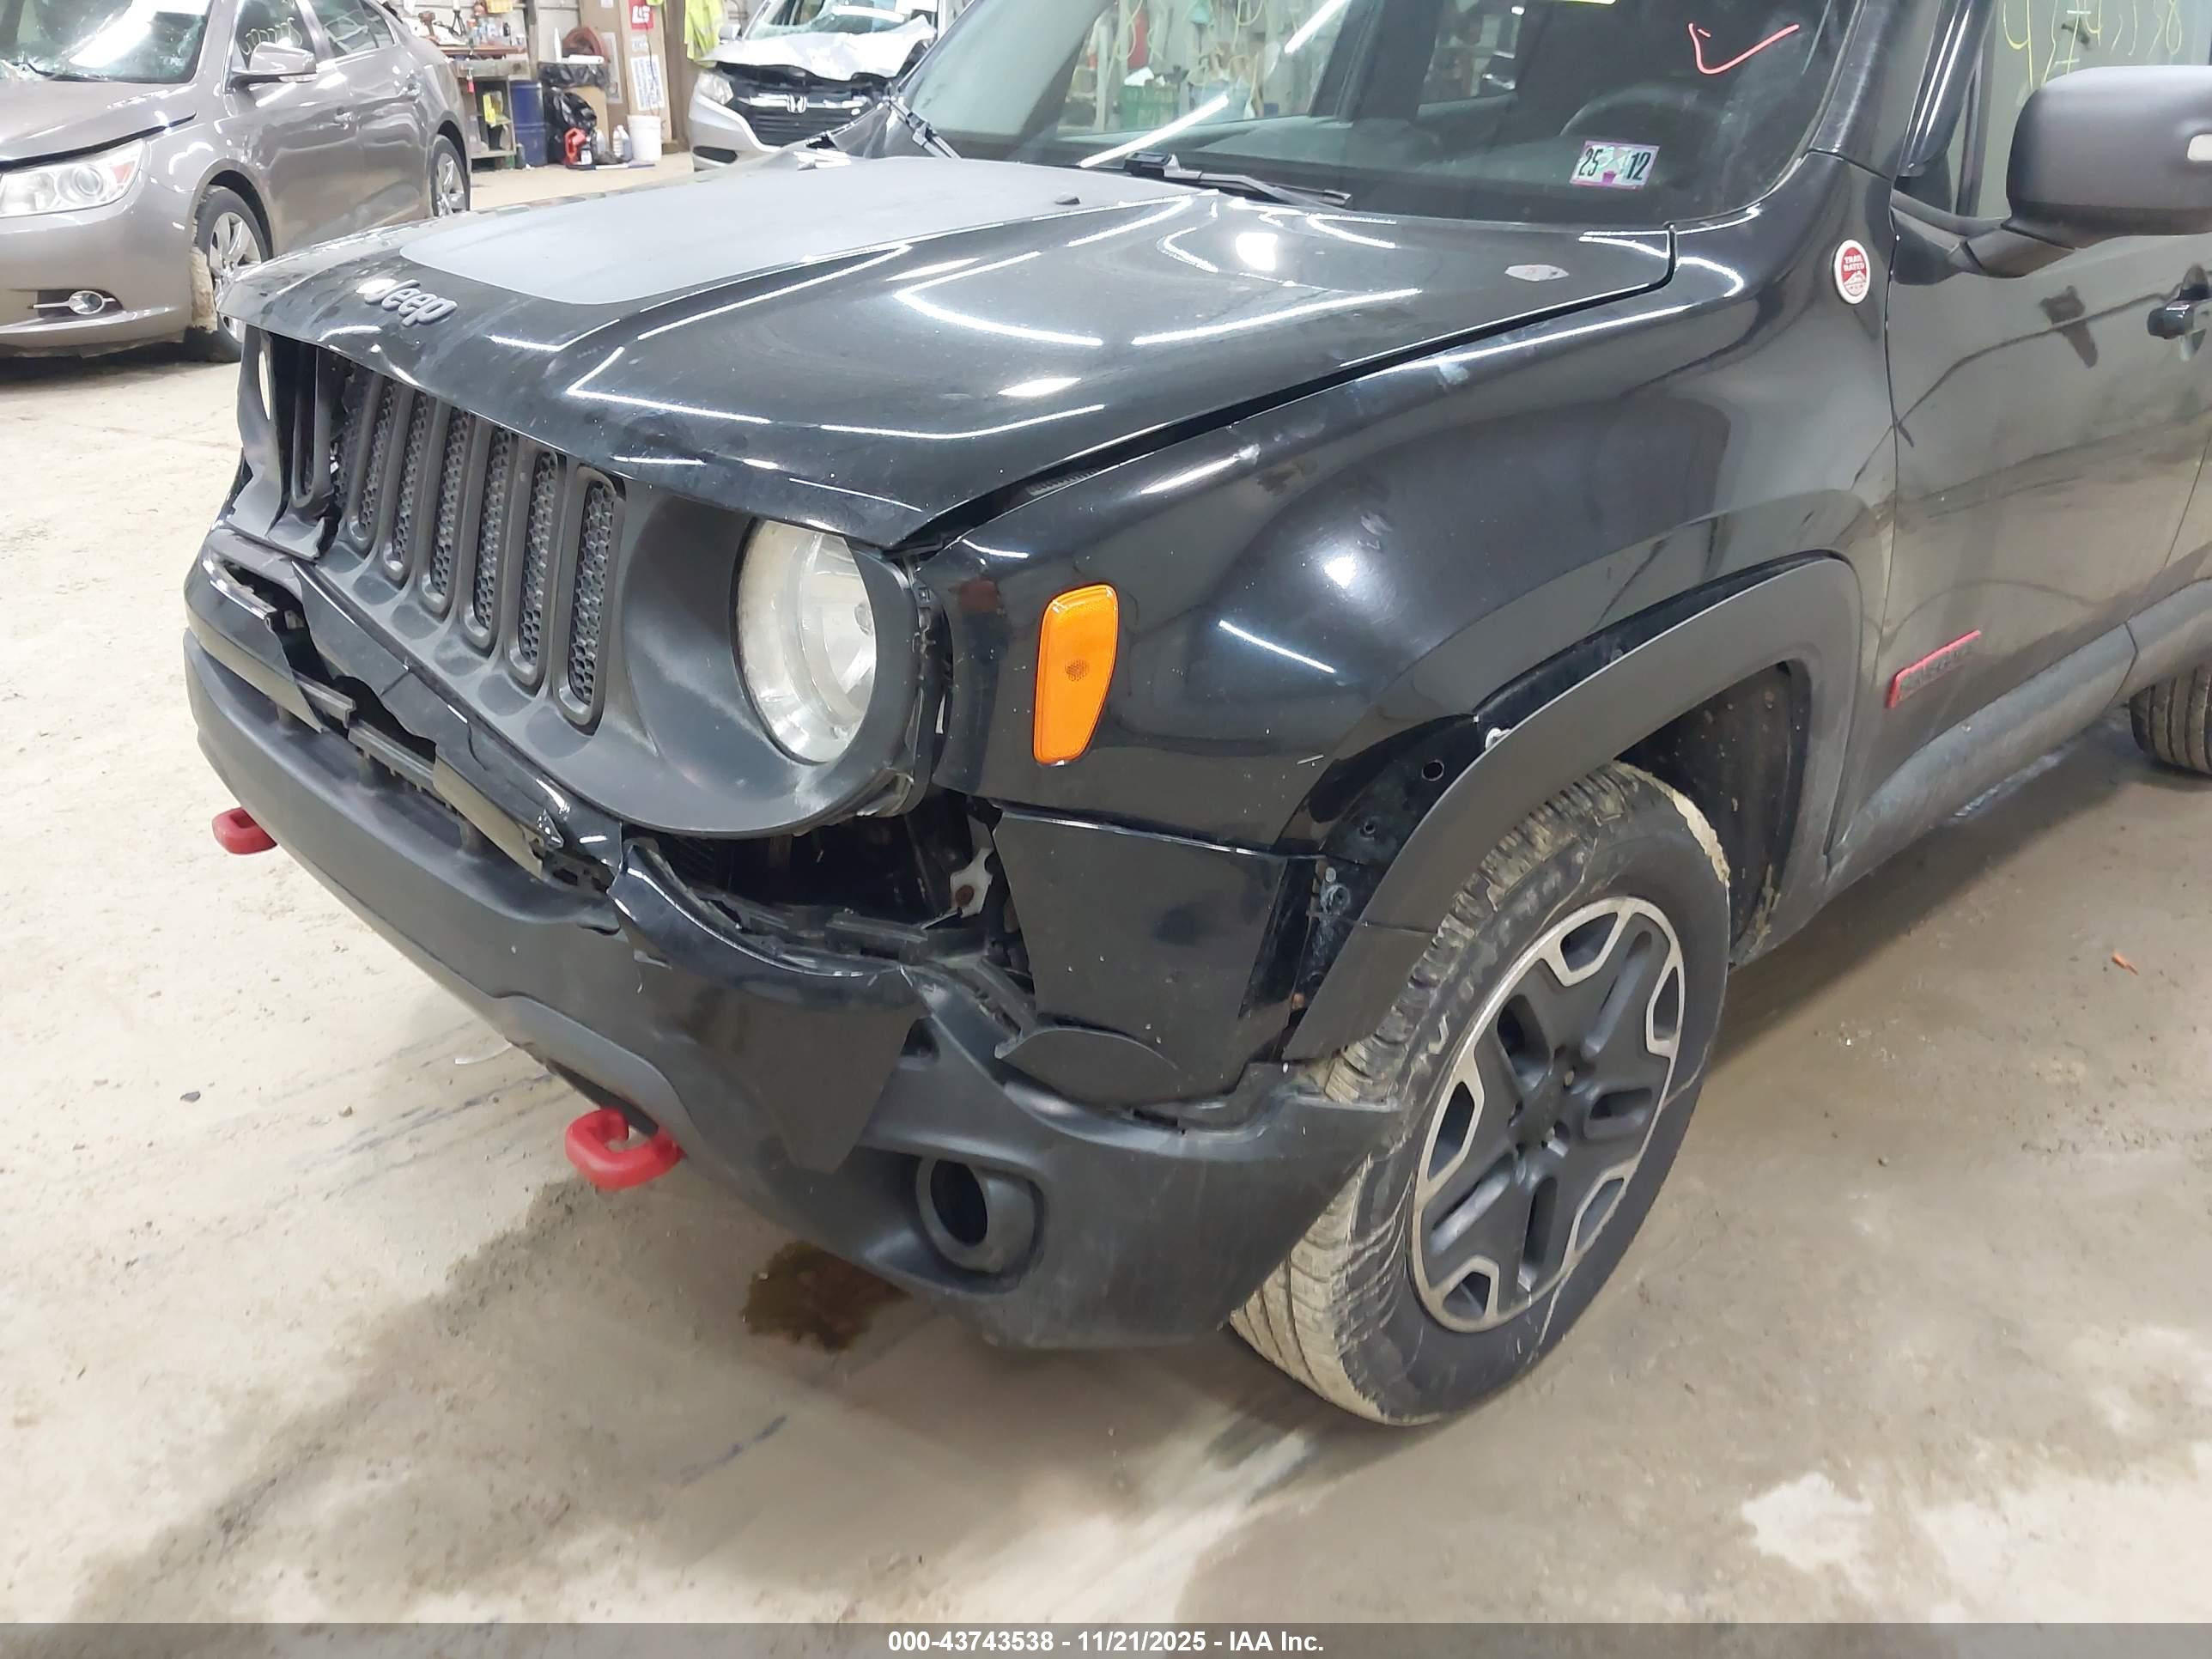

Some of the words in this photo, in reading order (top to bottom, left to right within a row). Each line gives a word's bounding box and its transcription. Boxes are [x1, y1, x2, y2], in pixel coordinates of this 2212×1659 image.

[1577, 148, 1604, 177] 25
[1626, 151, 1652, 181] 12
[364, 279, 459, 326] Jeep
